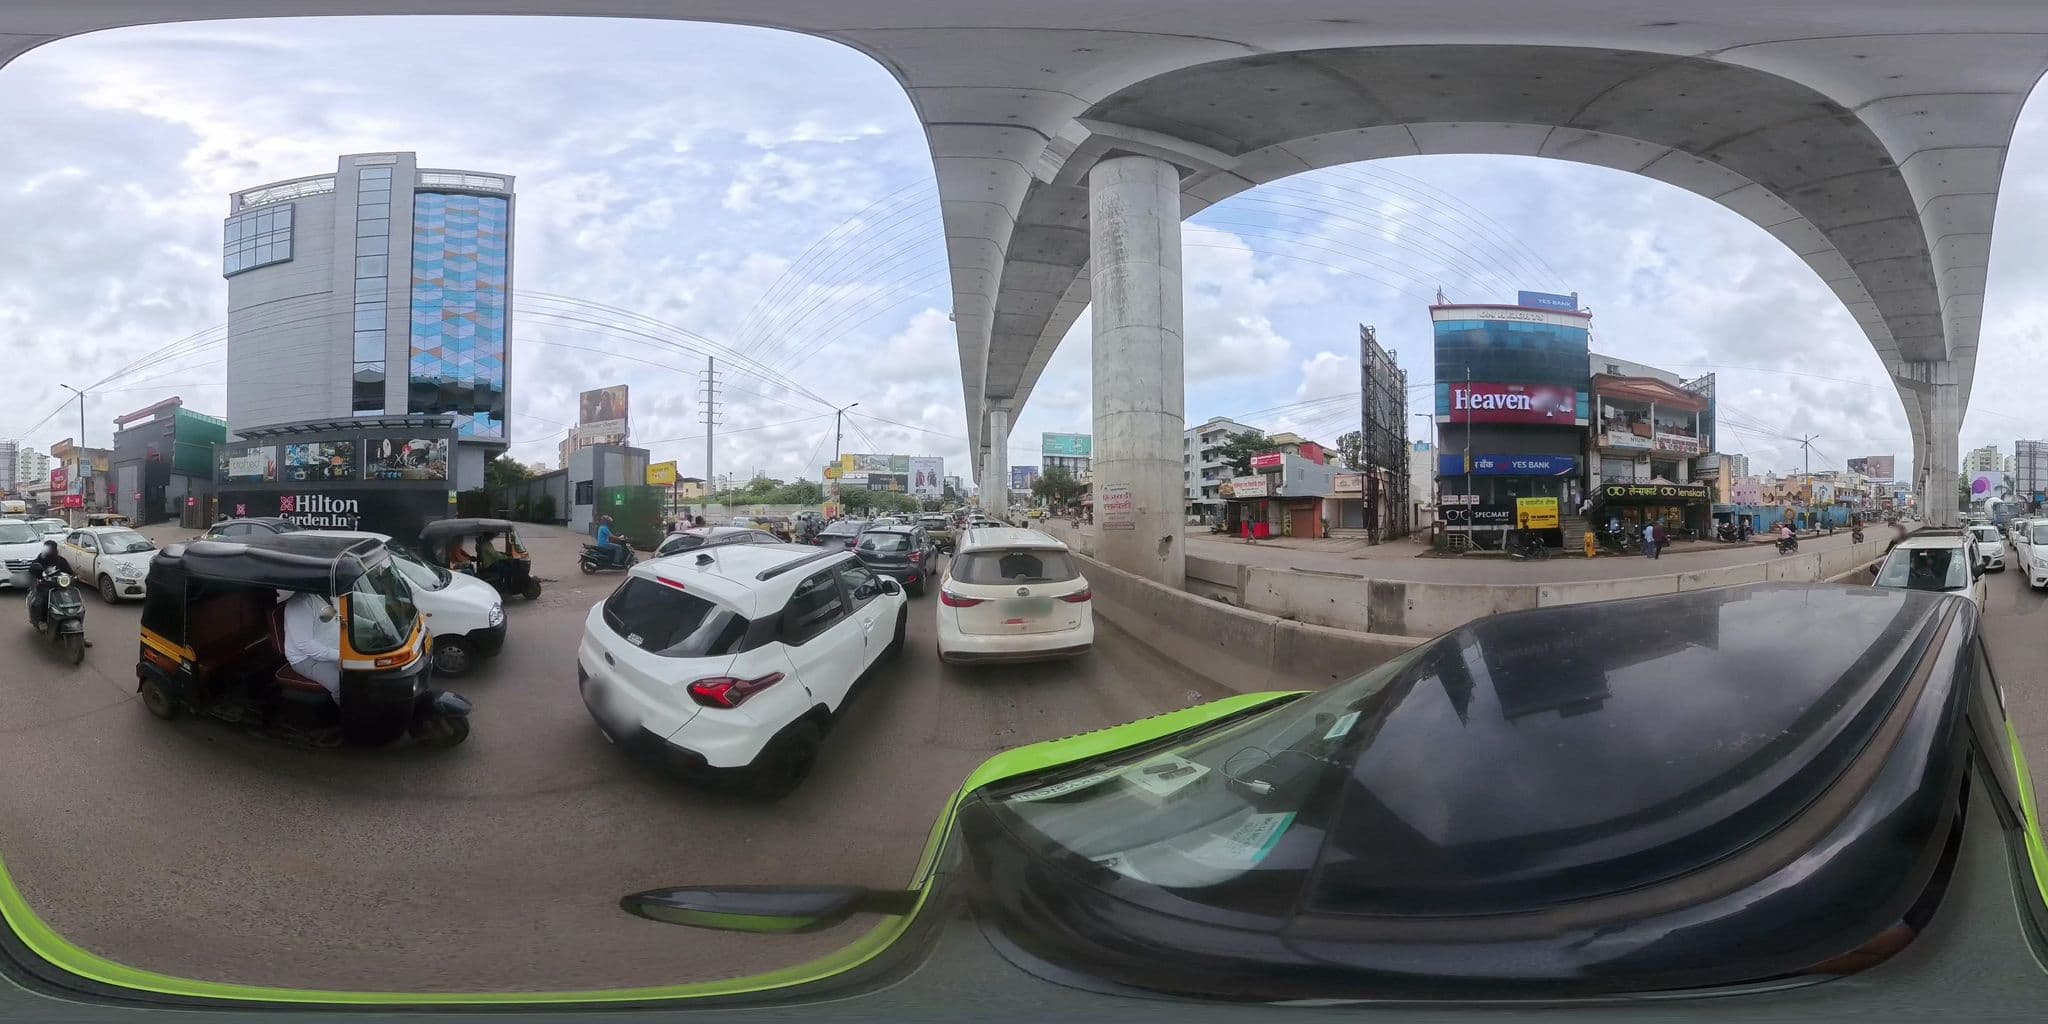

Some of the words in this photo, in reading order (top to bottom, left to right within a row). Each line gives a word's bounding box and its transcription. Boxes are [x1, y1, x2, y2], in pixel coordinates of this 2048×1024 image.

[1455, 389, 1530, 410] Heaven
[1512, 461, 1527, 469] YES
[1528, 461, 1550, 469] BANK
[1677, 487, 1706, 497] lenskart
[296, 494, 358, 513] Hilton
[1475, 510, 1509, 518] SPECMART
